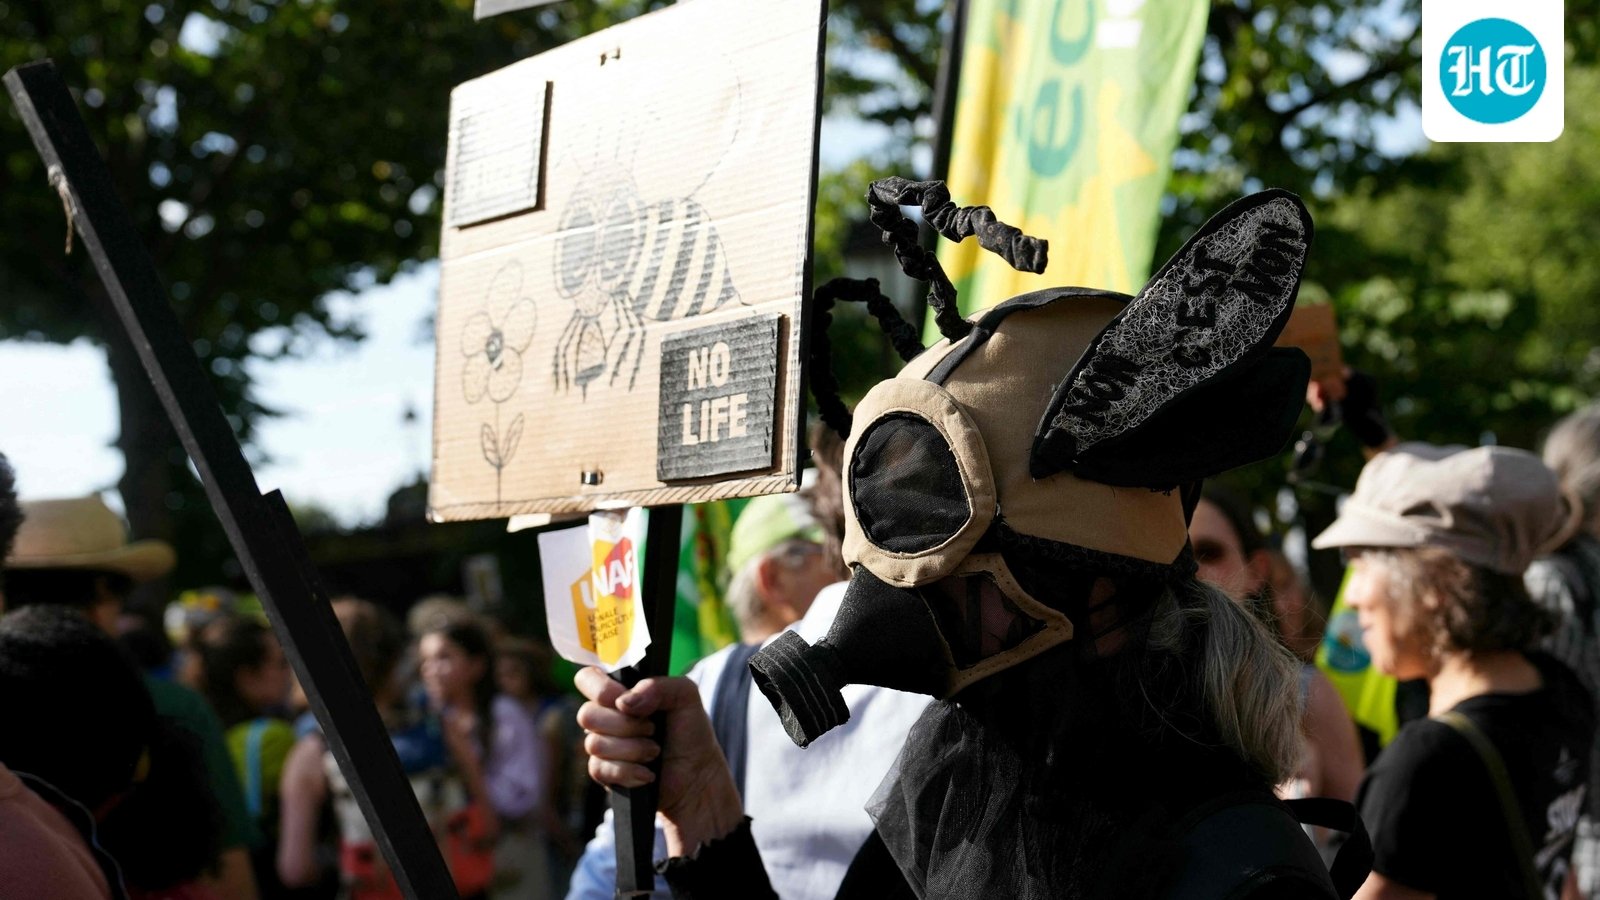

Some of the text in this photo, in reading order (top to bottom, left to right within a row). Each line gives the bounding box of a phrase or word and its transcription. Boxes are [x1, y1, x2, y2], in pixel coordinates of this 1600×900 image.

[1230, 221, 1301, 307] NON
[687, 341, 731, 391] NO
[1064, 354, 1142, 427] NON
[682, 393, 748, 445] LIFE
